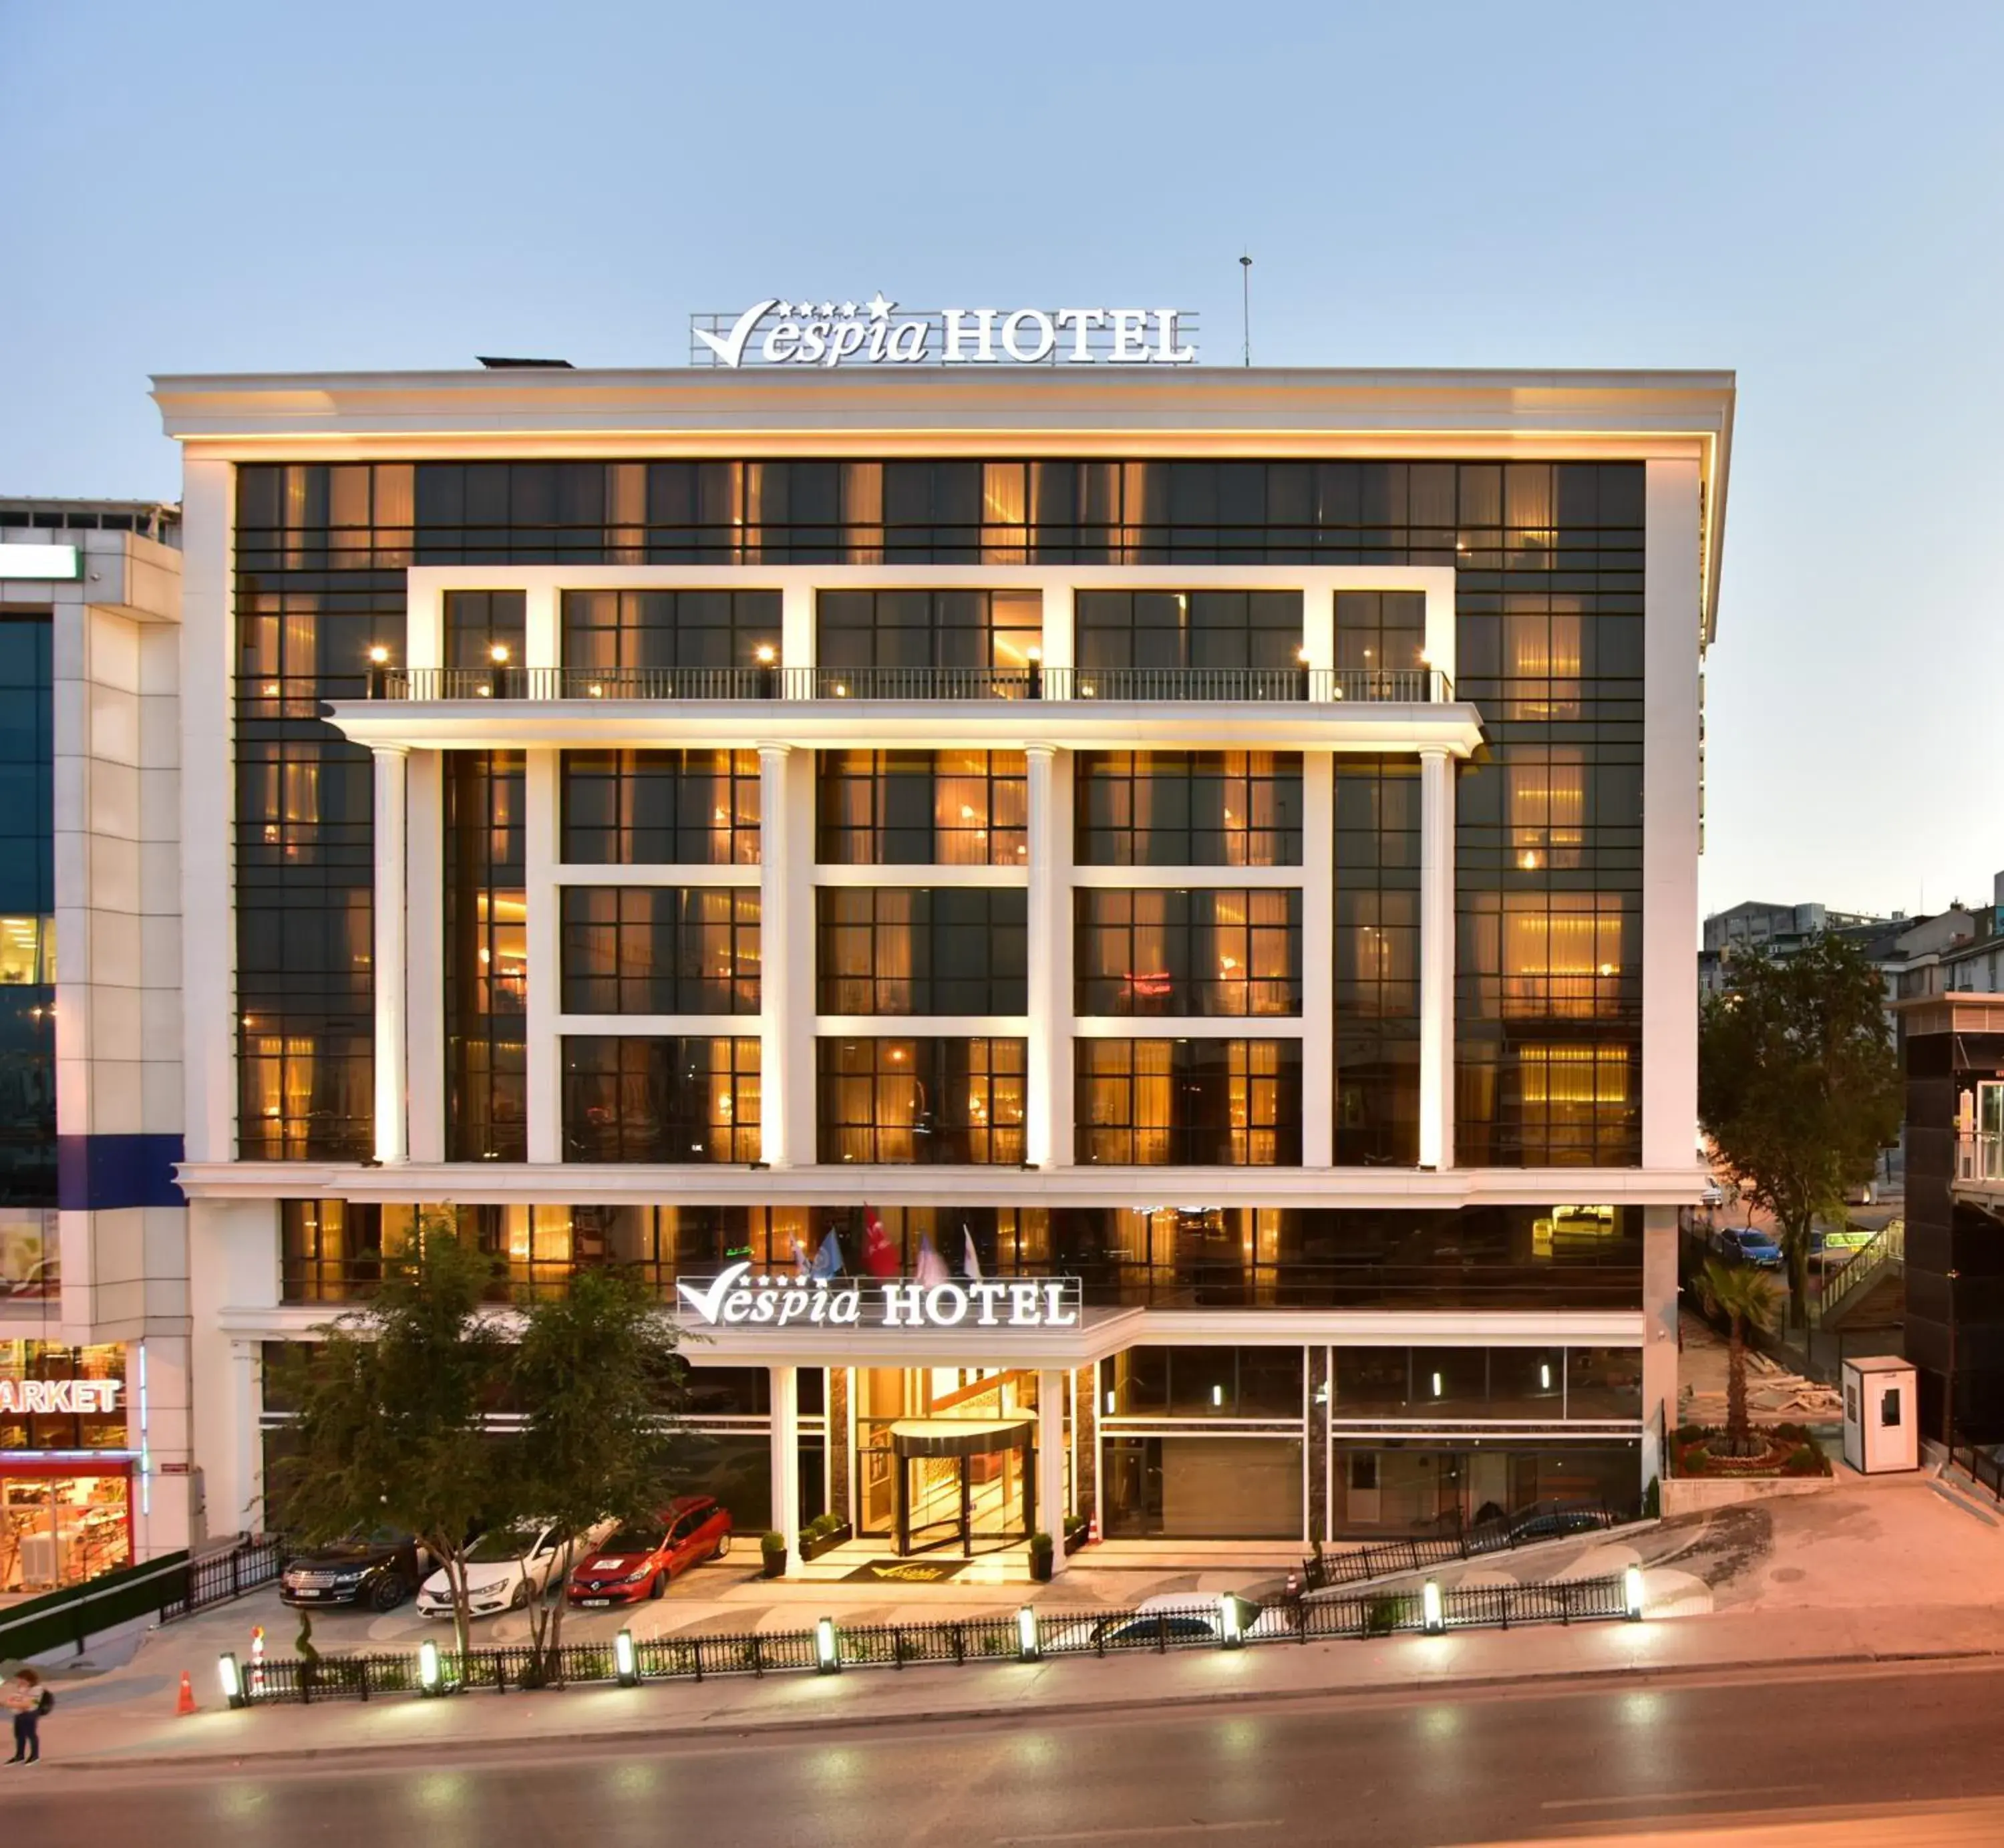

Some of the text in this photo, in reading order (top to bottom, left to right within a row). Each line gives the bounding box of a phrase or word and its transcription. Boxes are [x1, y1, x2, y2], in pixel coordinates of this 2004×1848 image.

[693, 297, 1194, 367] Vespia HOTEL
[676, 1261, 1076, 1326] Vespia HOTEL
[0, 1379, 122, 1413] ARKET
